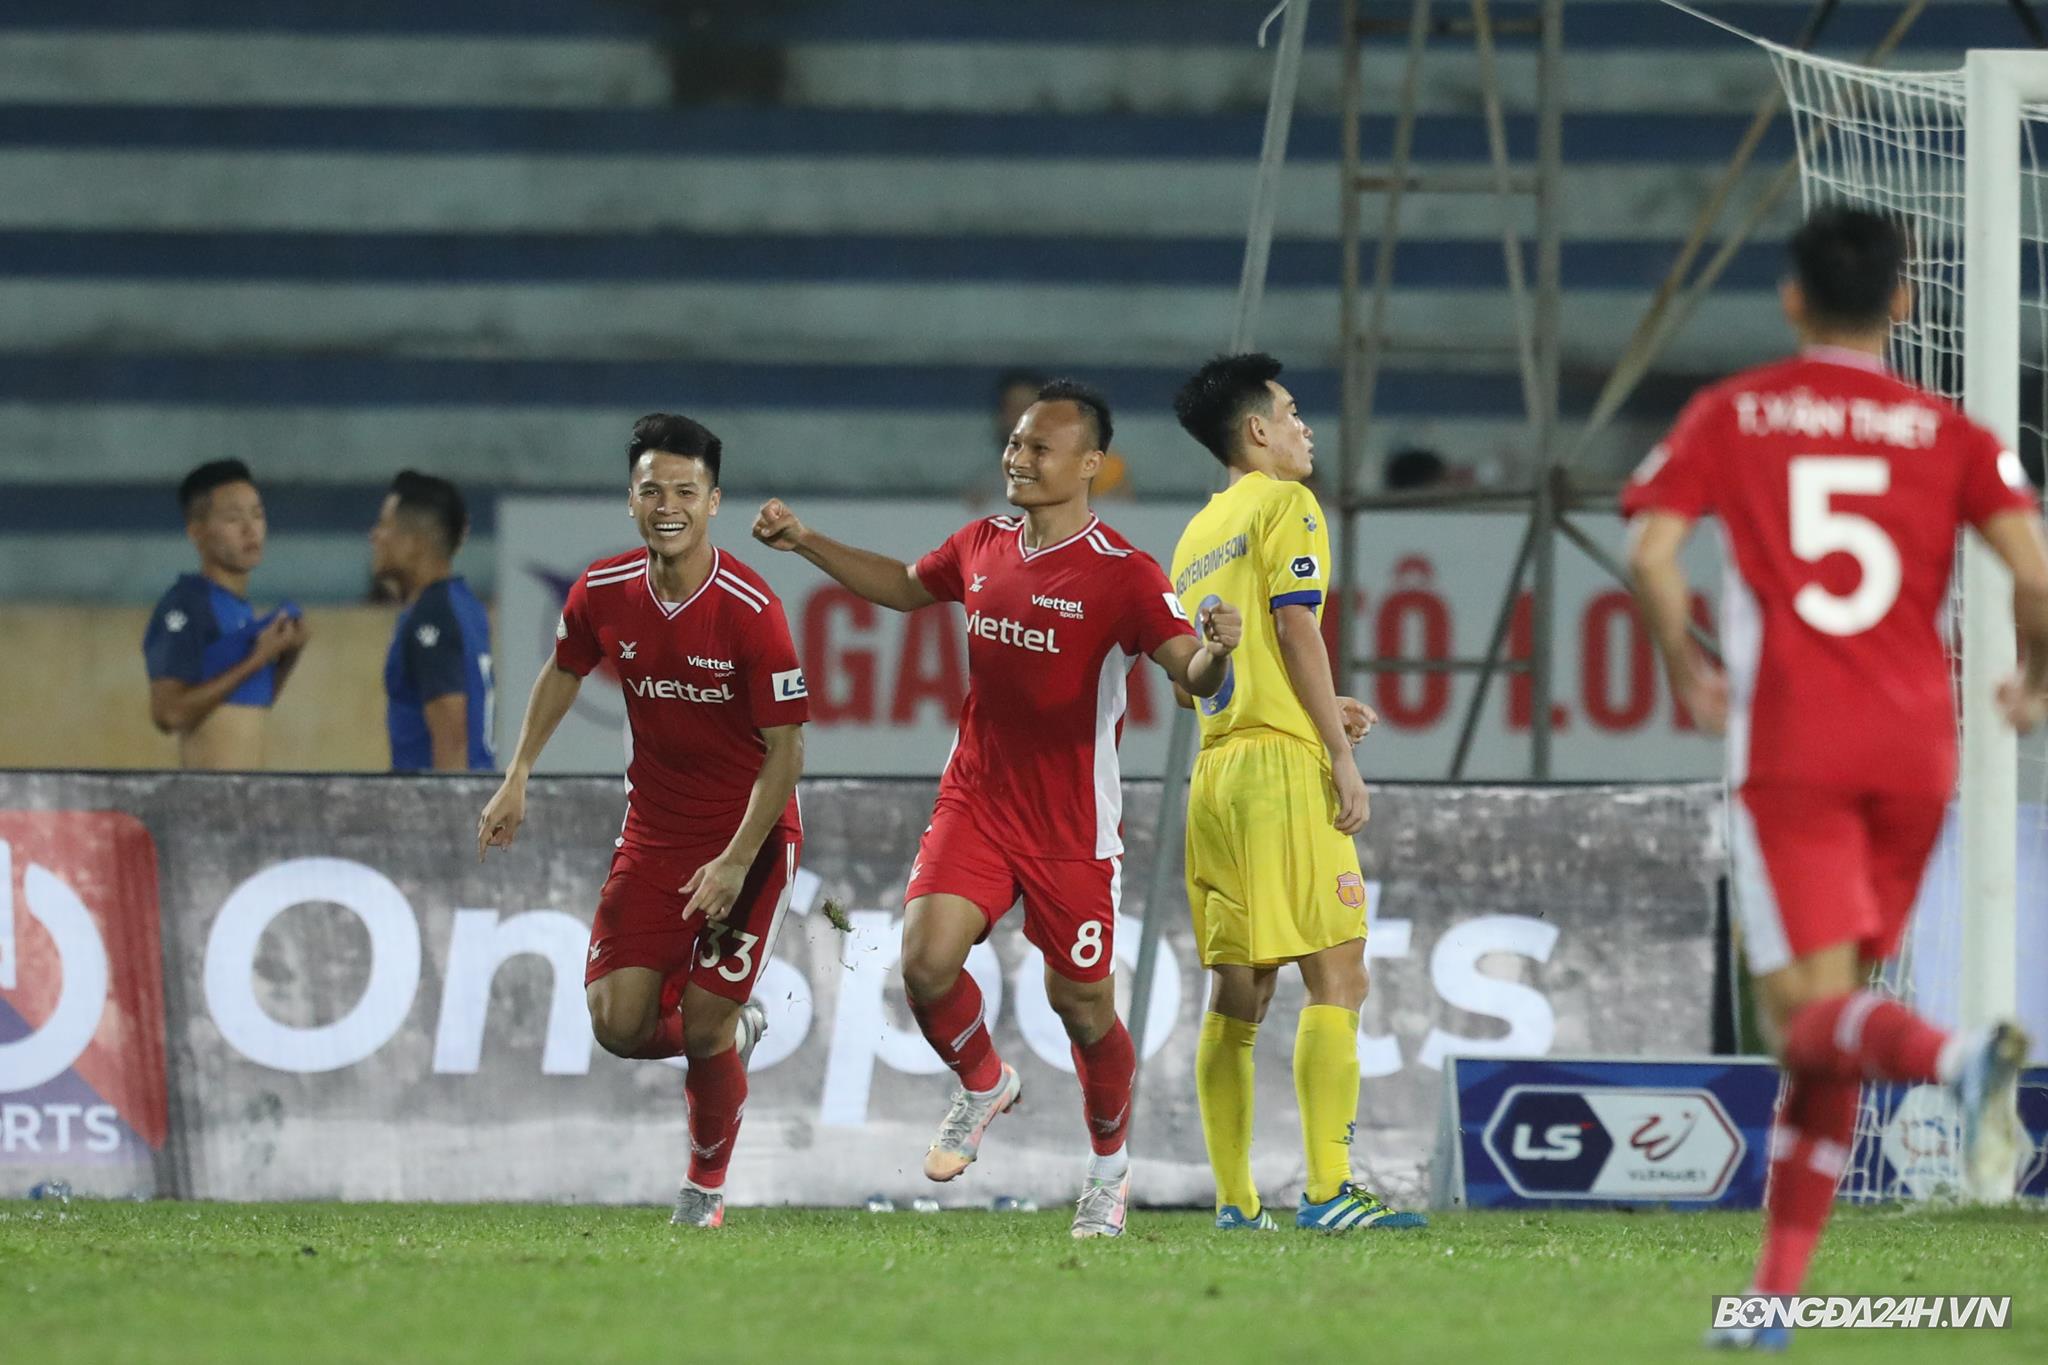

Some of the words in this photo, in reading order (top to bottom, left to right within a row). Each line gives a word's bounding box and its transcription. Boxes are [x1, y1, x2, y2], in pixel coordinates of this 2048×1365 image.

[1789, 454, 1902, 637] 5
[1294, 562, 1310, 572] LS
[1031, 594, 1083, 613] viettel
[1059, 611, 1084, 620] sports
[967, 610, 1060, 654] viettel
[687, 655, 735, 670] viettel
[627, 676, 735, 704] viettel
[700, 920, 760, 982] 33
[1071, 920, 1103, 968] 8
[0, 1103, 121, 1153] RTS
[1512, 1122, 1583, 1161] LS
